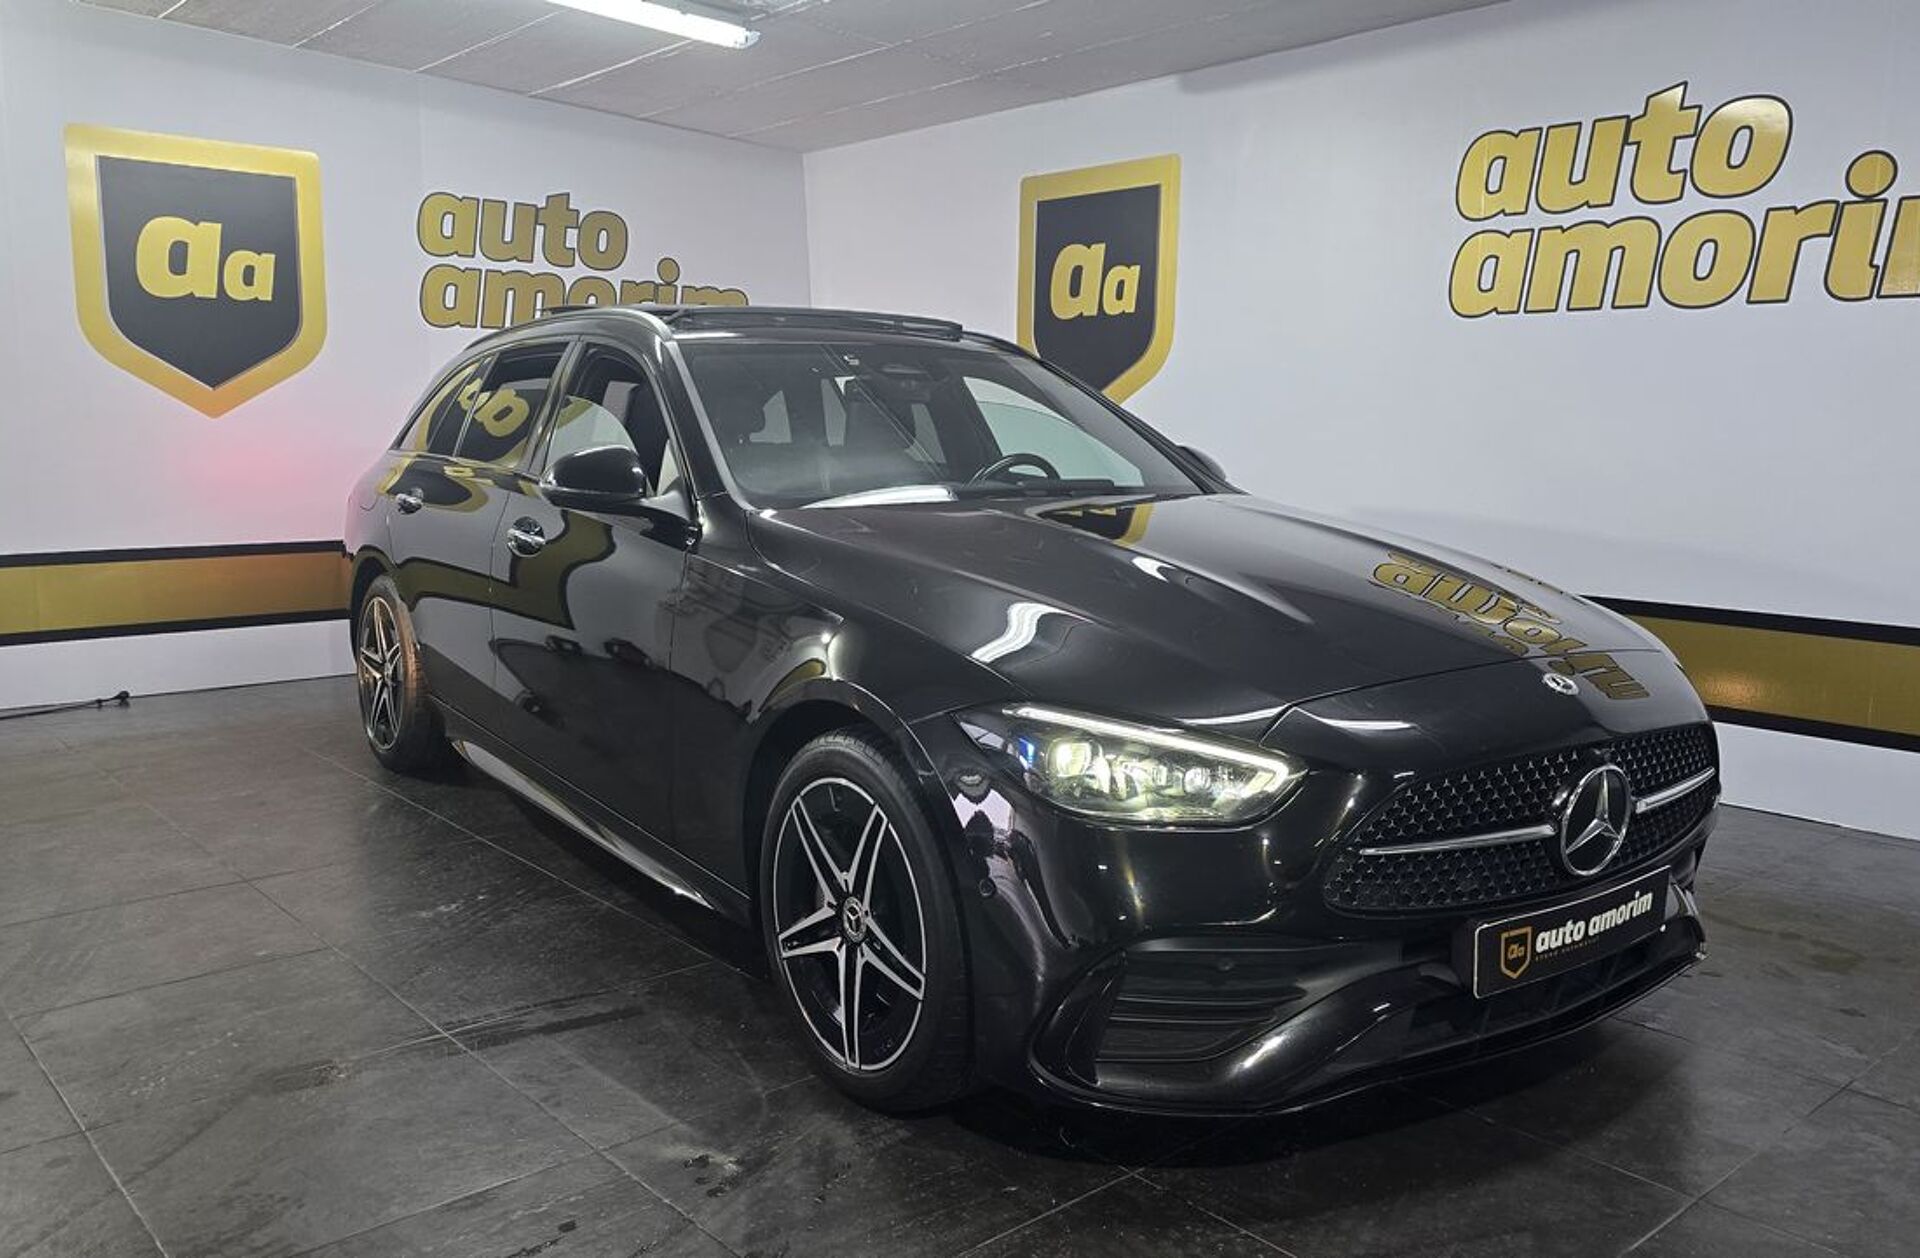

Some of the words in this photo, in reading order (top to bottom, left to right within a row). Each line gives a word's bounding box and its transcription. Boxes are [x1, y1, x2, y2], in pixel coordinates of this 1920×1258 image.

[1455, 81, 1793, 222] auto
[417, 192, 628, 271] auto
[1535, 919, 1586, 953] auto
[1588, 890, 1654, 936] amorim
